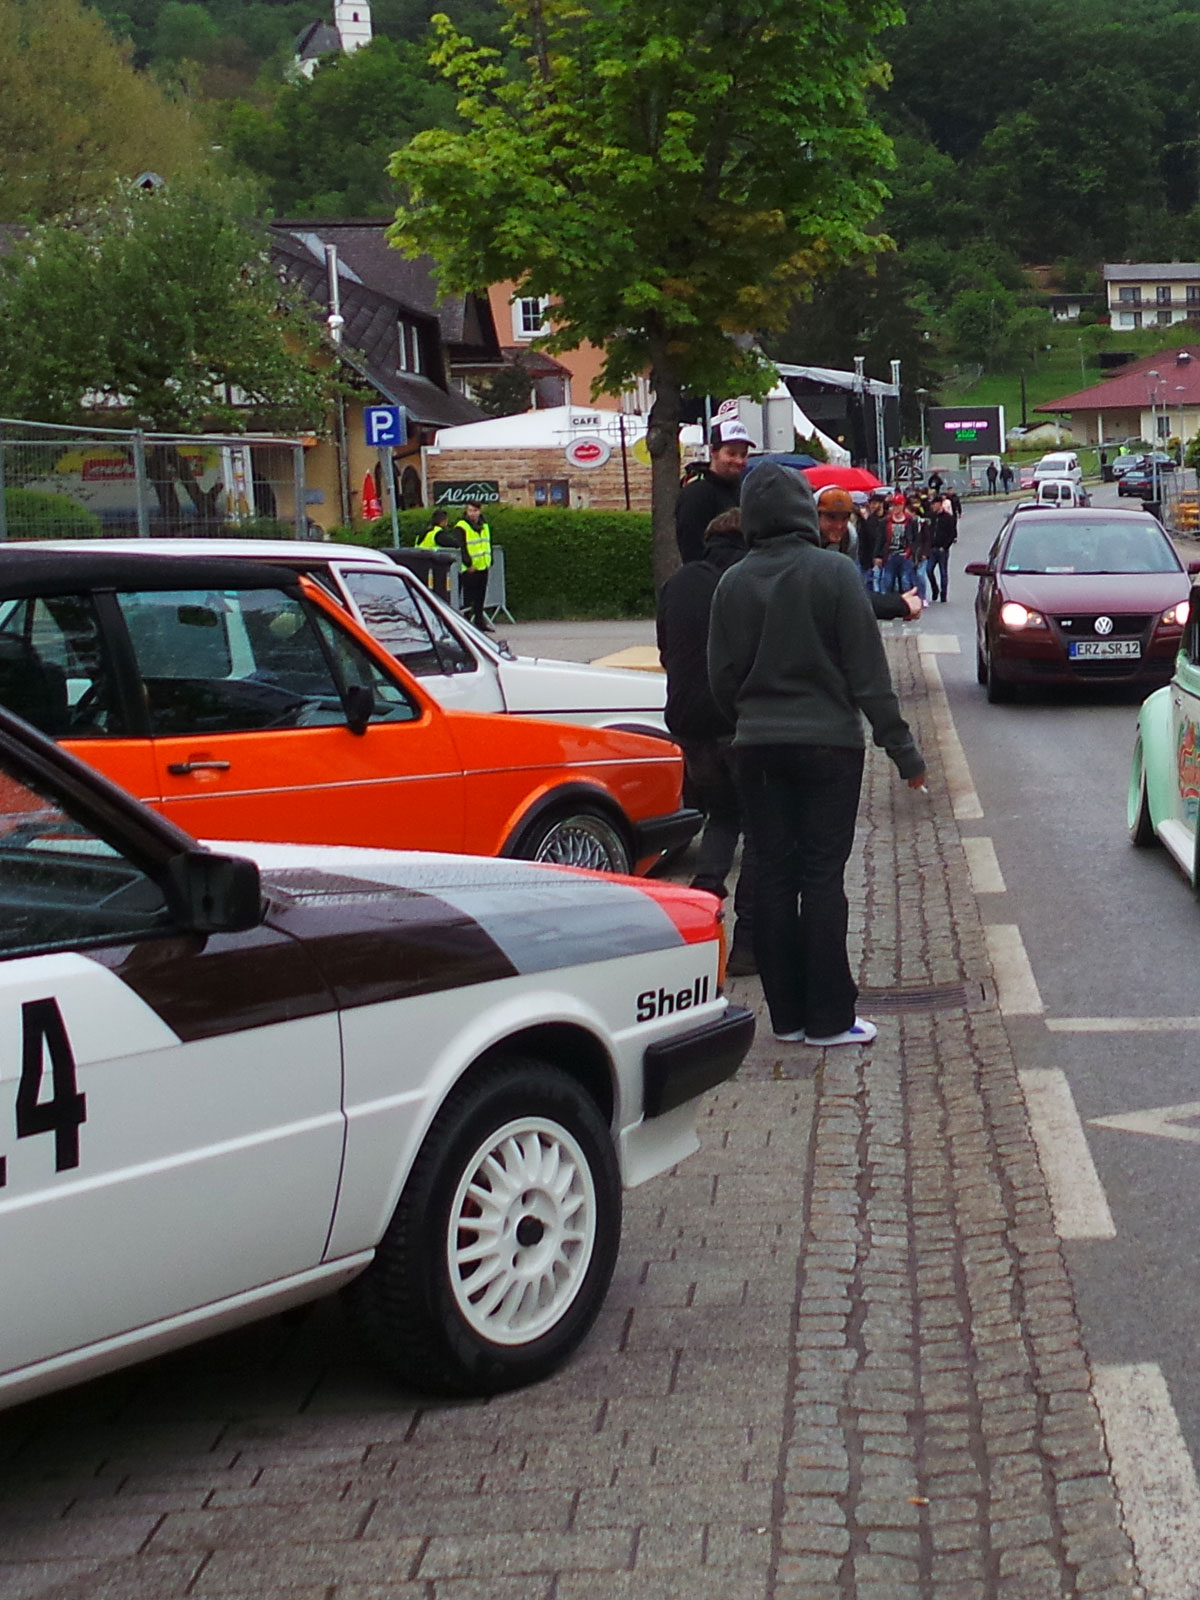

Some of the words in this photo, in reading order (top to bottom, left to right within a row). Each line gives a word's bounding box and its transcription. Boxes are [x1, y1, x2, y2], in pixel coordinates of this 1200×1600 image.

[371, 411, 393, 442] P
[572, 417, 599, 425] CAFE
[435, 488, 499, 504] Almino
[1077, 643, 1100, 655] ERZ
[1108, 642, 1123, 654] SR
[1126, 642, 1139, 653] 12
[636, 976, 709, 1022] Shell
[0, 997, 87, 1187] 4
